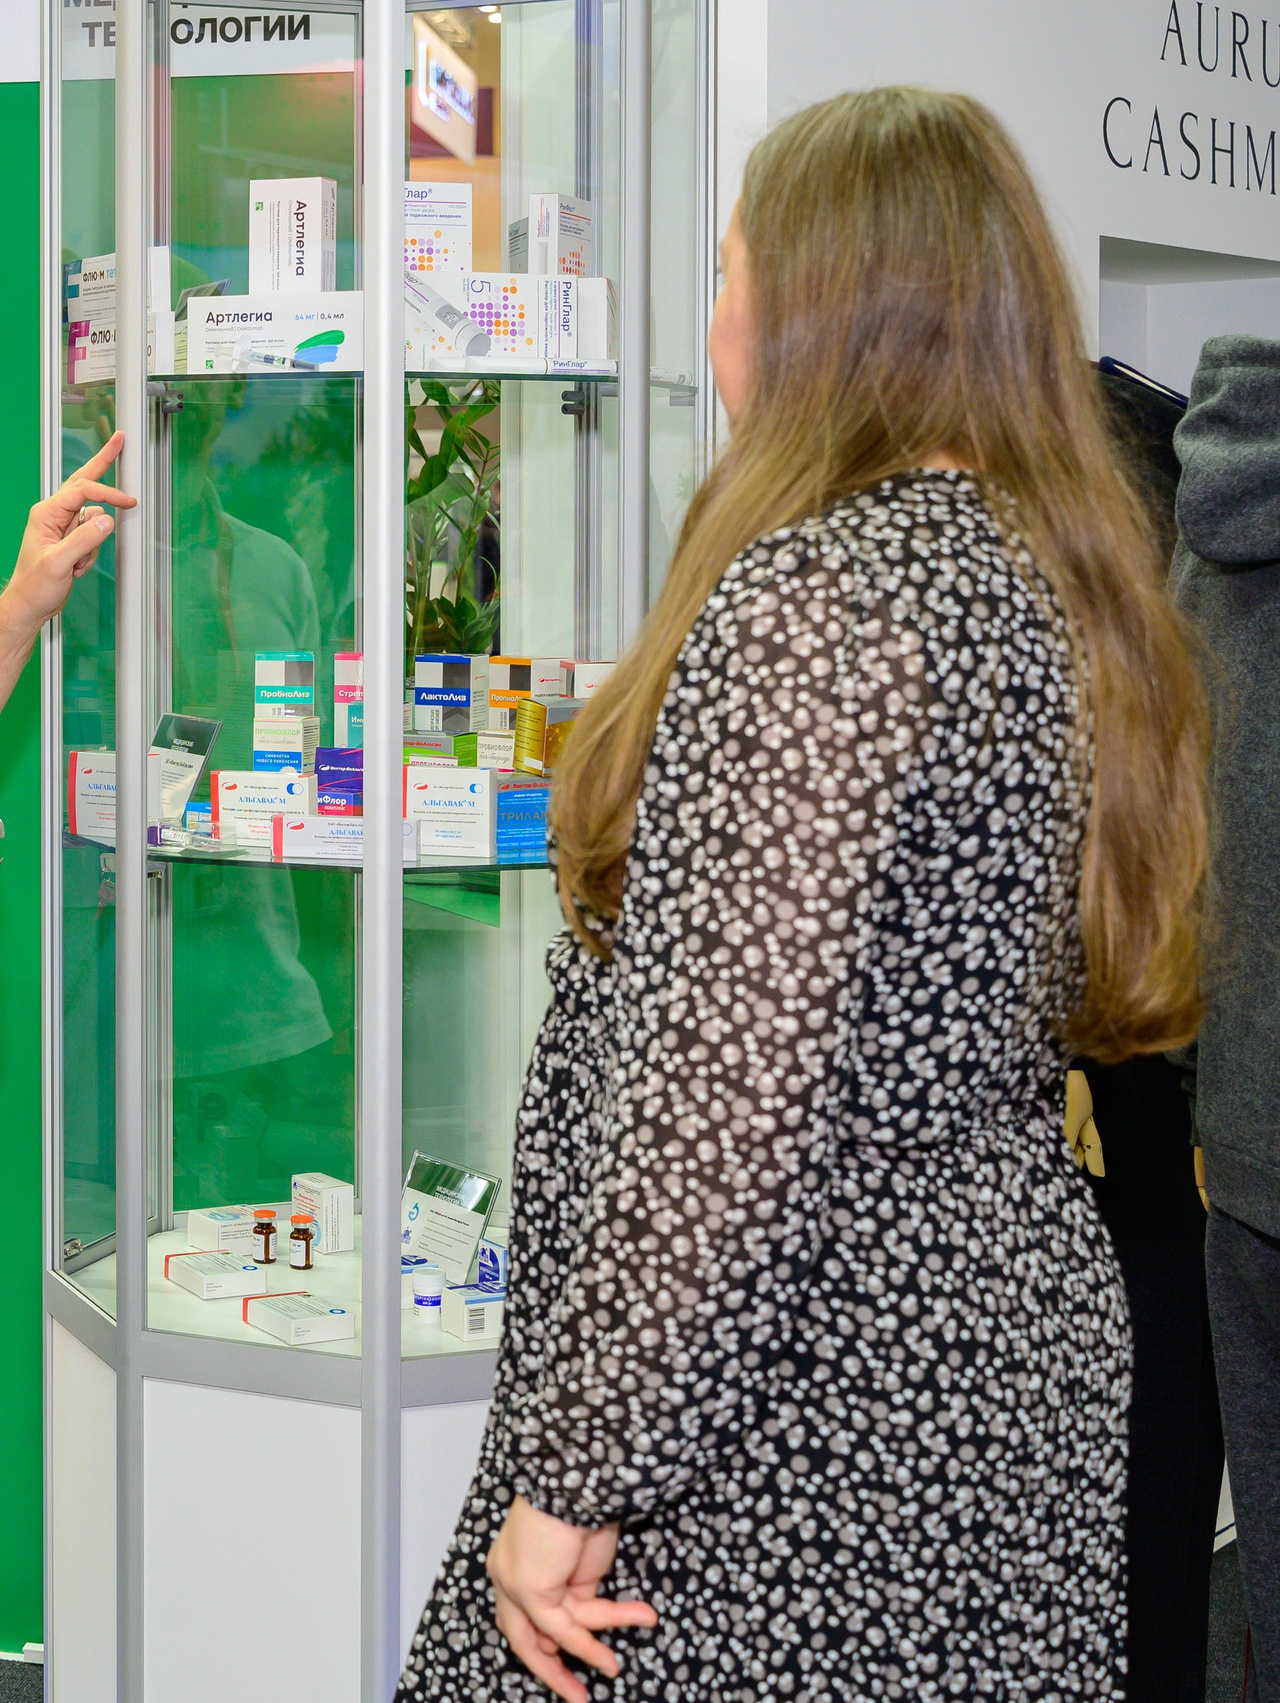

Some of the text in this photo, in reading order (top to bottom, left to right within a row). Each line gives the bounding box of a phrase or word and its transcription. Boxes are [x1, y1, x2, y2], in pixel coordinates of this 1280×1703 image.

[1102, 96, 1277, 196] CASHM
[294, 199, 308, 277] Артлегиа
[470, 279, 491, 294] 5
[561, 281, 572, 337] РинГлар®
[205, 310, 273, 326] Артлегиа
[295, 313, 305, 321] 64
[305, 314, 315, 322] мг
[320, 313, 332, 321] 0,4
[260, 690, 310, 699] ПробиоЛиз
[420, 692, 467, 702] ЛактоЛиз
[255, 728, 301, 736] ПРОБИОФЛОР
[477, 743, 513, 752] ПРОБИОФЛОР
[87, 783, 117, 791] АЛЬГАВА
